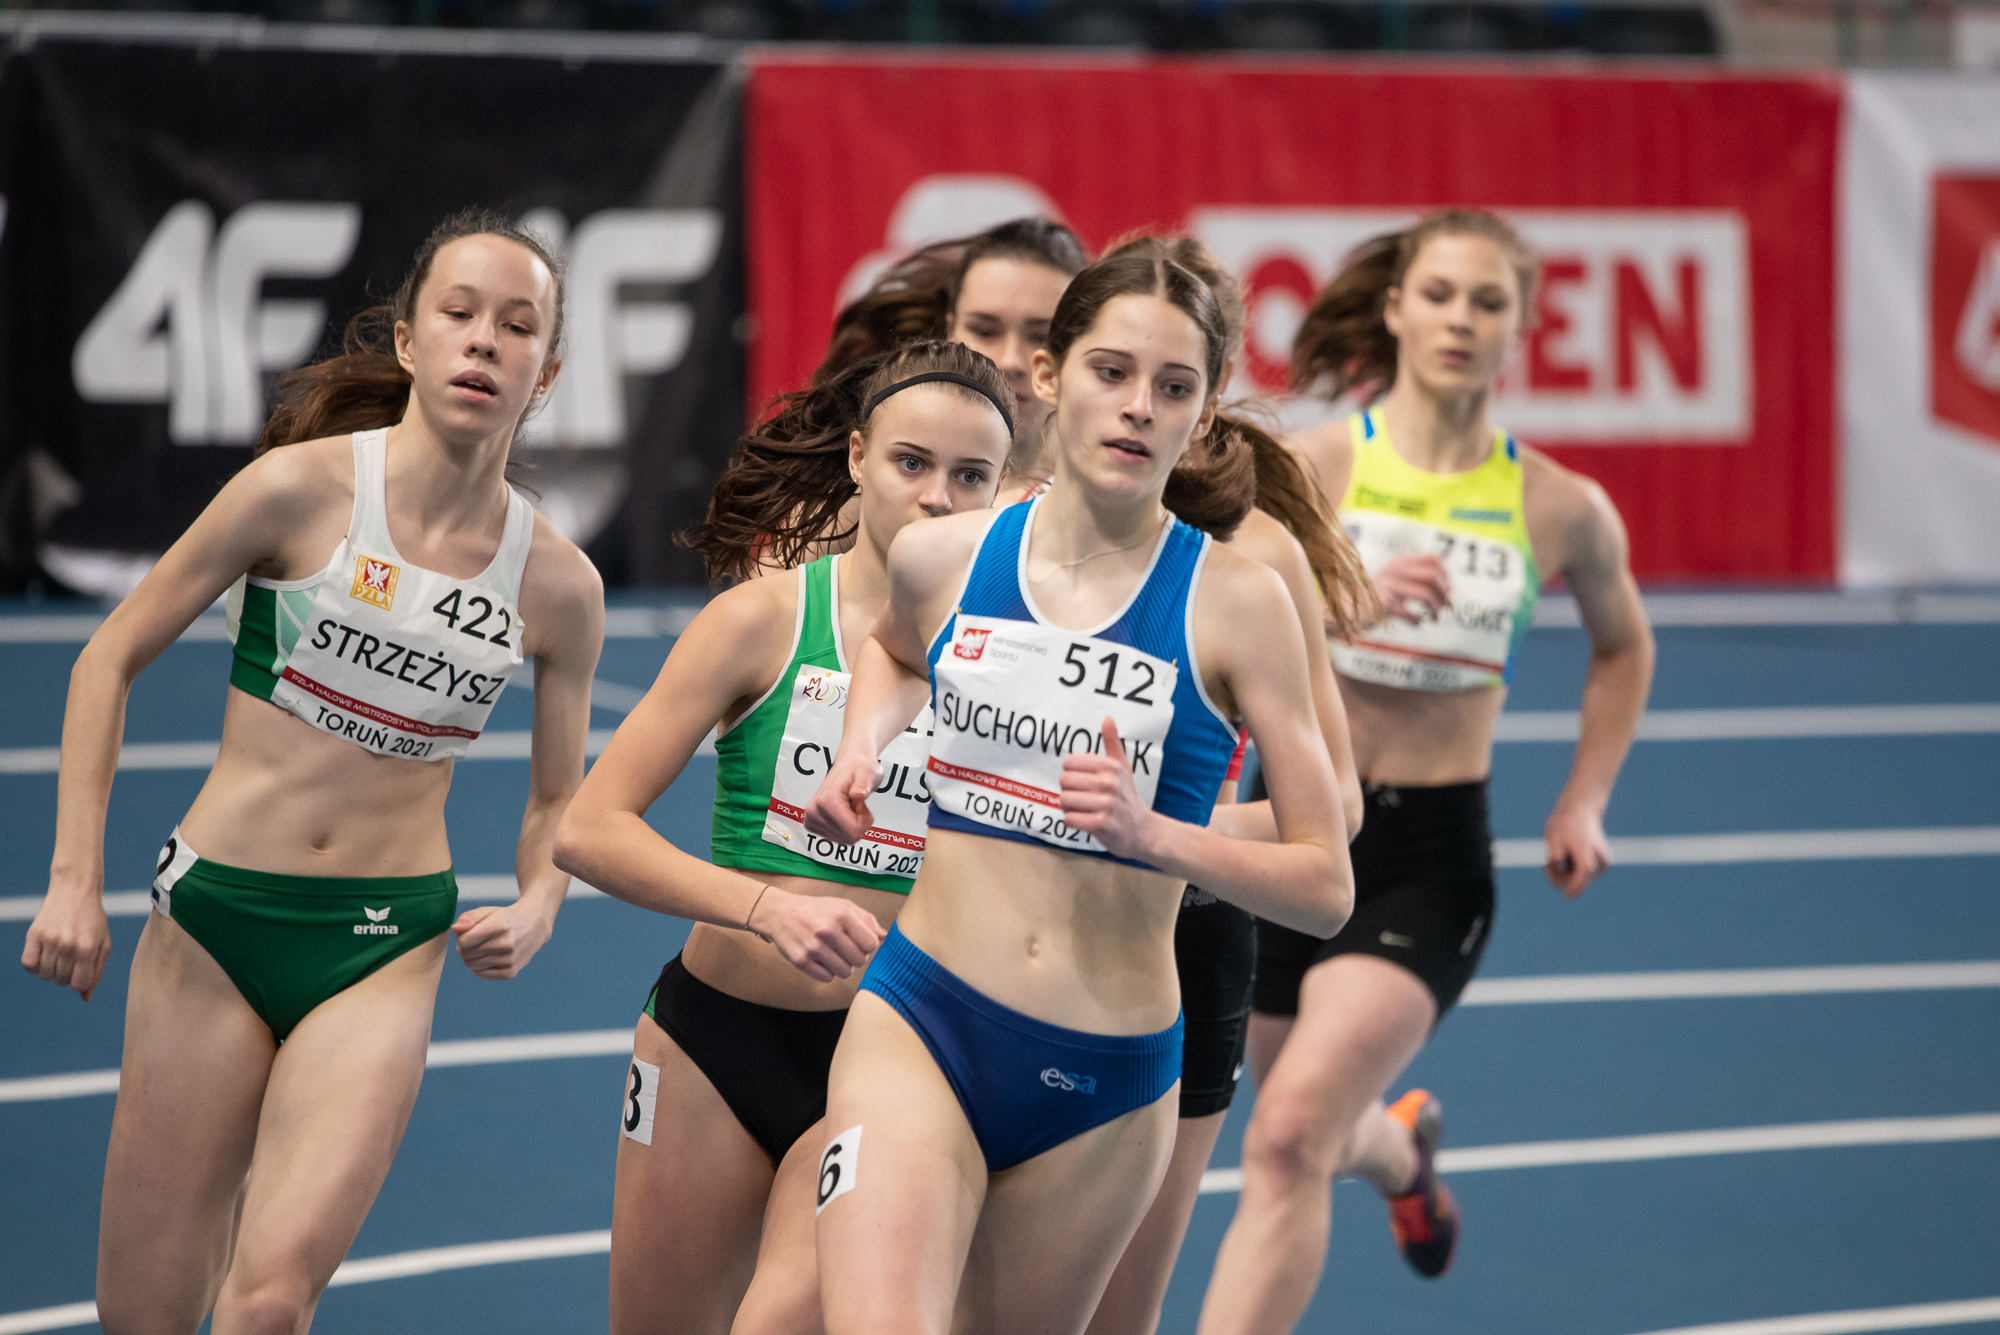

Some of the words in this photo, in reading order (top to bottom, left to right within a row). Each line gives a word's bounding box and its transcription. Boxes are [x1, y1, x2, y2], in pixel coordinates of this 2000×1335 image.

[73, 199, 362, 446] 4F
[1243, 252, 1702, 397] OEN
[1437, 531, 1510, 582] 713
[353, 584, 390, 609] PZLA
[433, 588, 511, 649] 422
[311, 619, 505, 705] STRZEŻYSZ
[1059, 642, 1155, 706] 512
[291, 673, 315, 691] PZLA
[315, 685, 353, 708] HALOWE
[352, 703, 415, 730] MISTRZOSTWA
[316, 706, 389, 750] TORUŃ
[389, 737, 434, 758] 2021
[942, 692, 1154, 776] SUCHOWOK
[933, 762, 955, 776] PZLA
[958, 771, 997, 786] HALOWE
[777, 803, 799, 818] PZLA
[964, 792, 1034, 829] TORUŃ
[806, 833, 881, 869] TORUŃ
[885, 854, 924, 874] 202
[353, 923, 399, 935] erima
[624, 1062, 642, 1132] 3
[817, 1143, 842, 1207] 6
